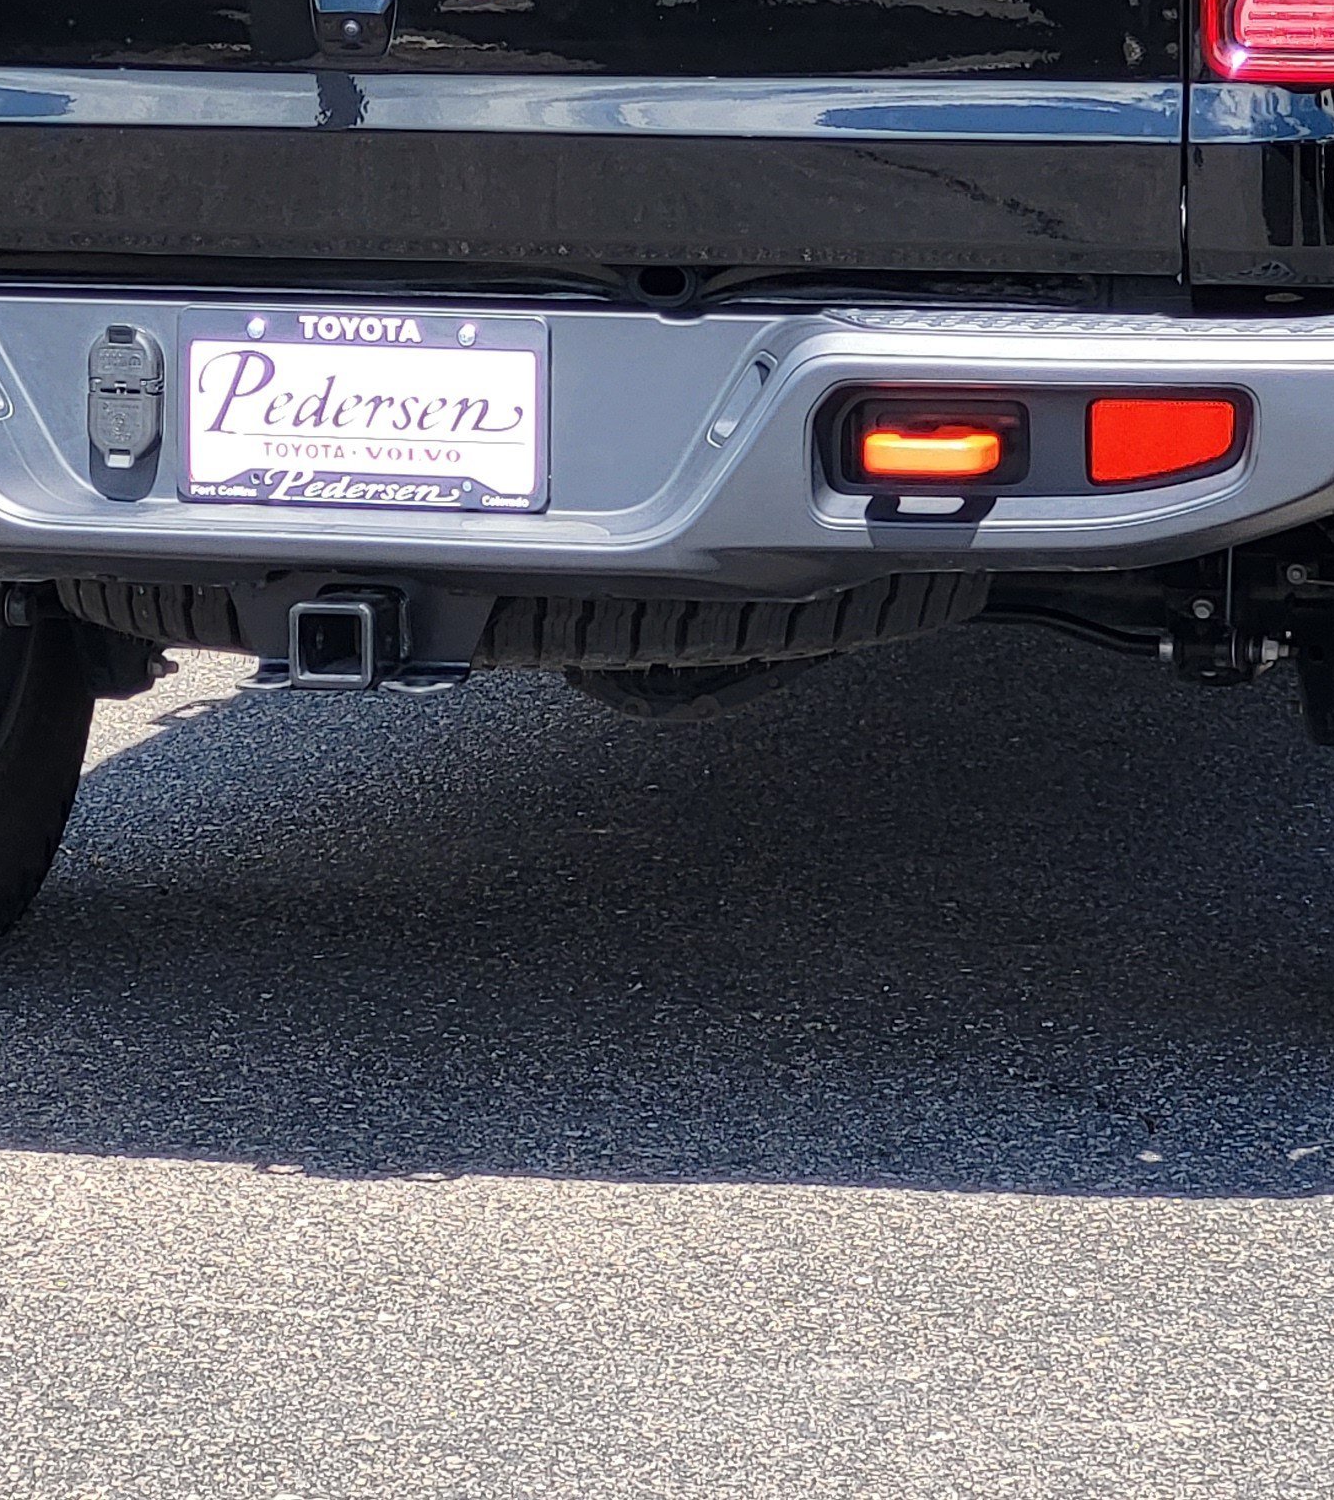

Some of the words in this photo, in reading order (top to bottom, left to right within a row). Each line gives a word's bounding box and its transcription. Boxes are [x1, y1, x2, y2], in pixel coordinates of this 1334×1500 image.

[299, 314, 422, 344] TOYOTA
[198, 349, 524, 434] Pedersen
[263, 442, 346, 460] TOYOTA
[365, 446, 462, 464] VOLVO
[190, 484, 216, 497] Fort
[217, 485, 259, 498] Collins
[263, 467, 462, 503] Pedersen
